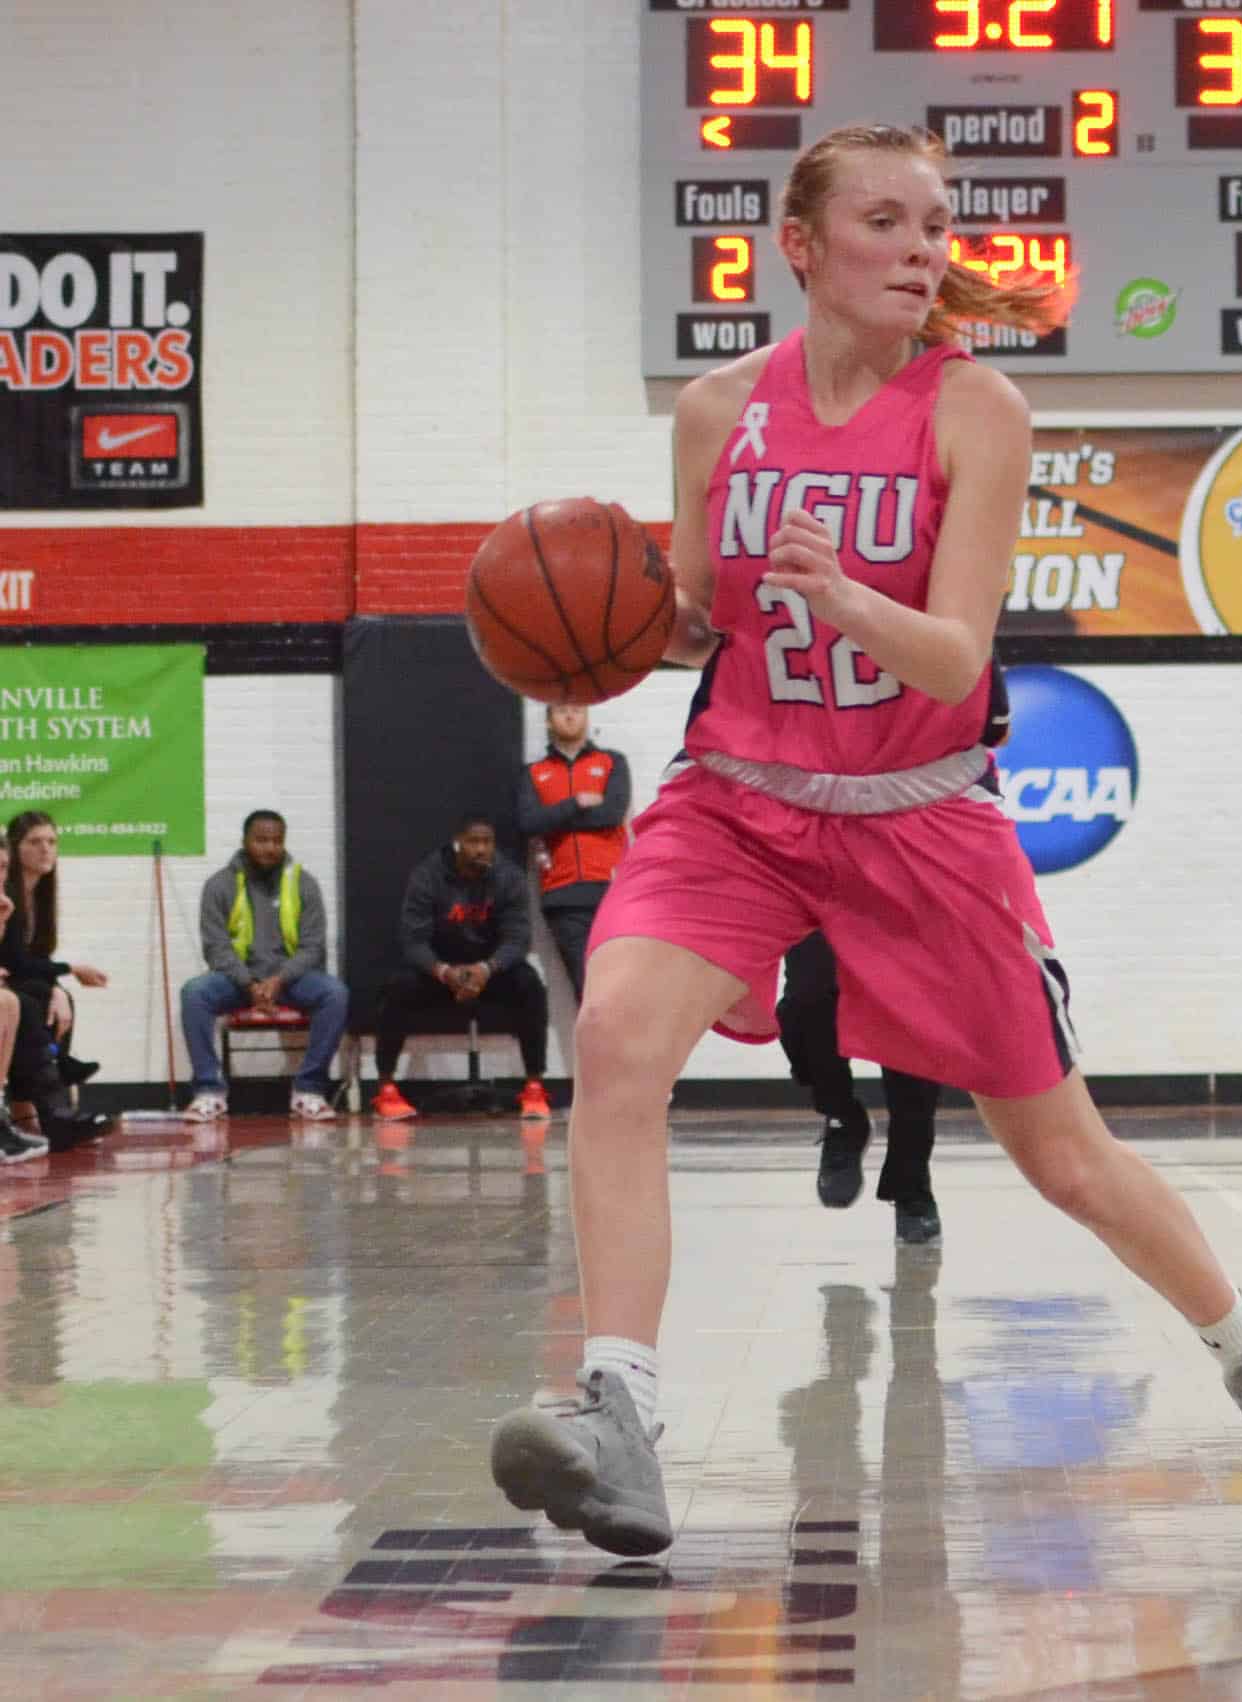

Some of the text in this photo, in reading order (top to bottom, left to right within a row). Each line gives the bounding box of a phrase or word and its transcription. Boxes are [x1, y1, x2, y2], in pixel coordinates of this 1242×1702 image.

[710, 19, 811, 104] 34
[944, 109, 1045, 150] period
[1075, 91, 1115, 154] 2
[684, 184, 762, 222] fouls
[710, 236, 750, 300] 2
[0, 251, 191, 328] DO IT.
[692, 320, 757, 351] won
[93, 462, 168, 477] TEAM
[719, 468, 919, 565] NGU
[1006, 553, 1125, 611] ION
[0, 687, 104, 711] NVILLE
[0, 716, 152, 740] TH SYSTEM
[26, 753, 109, 774] Hawkins
